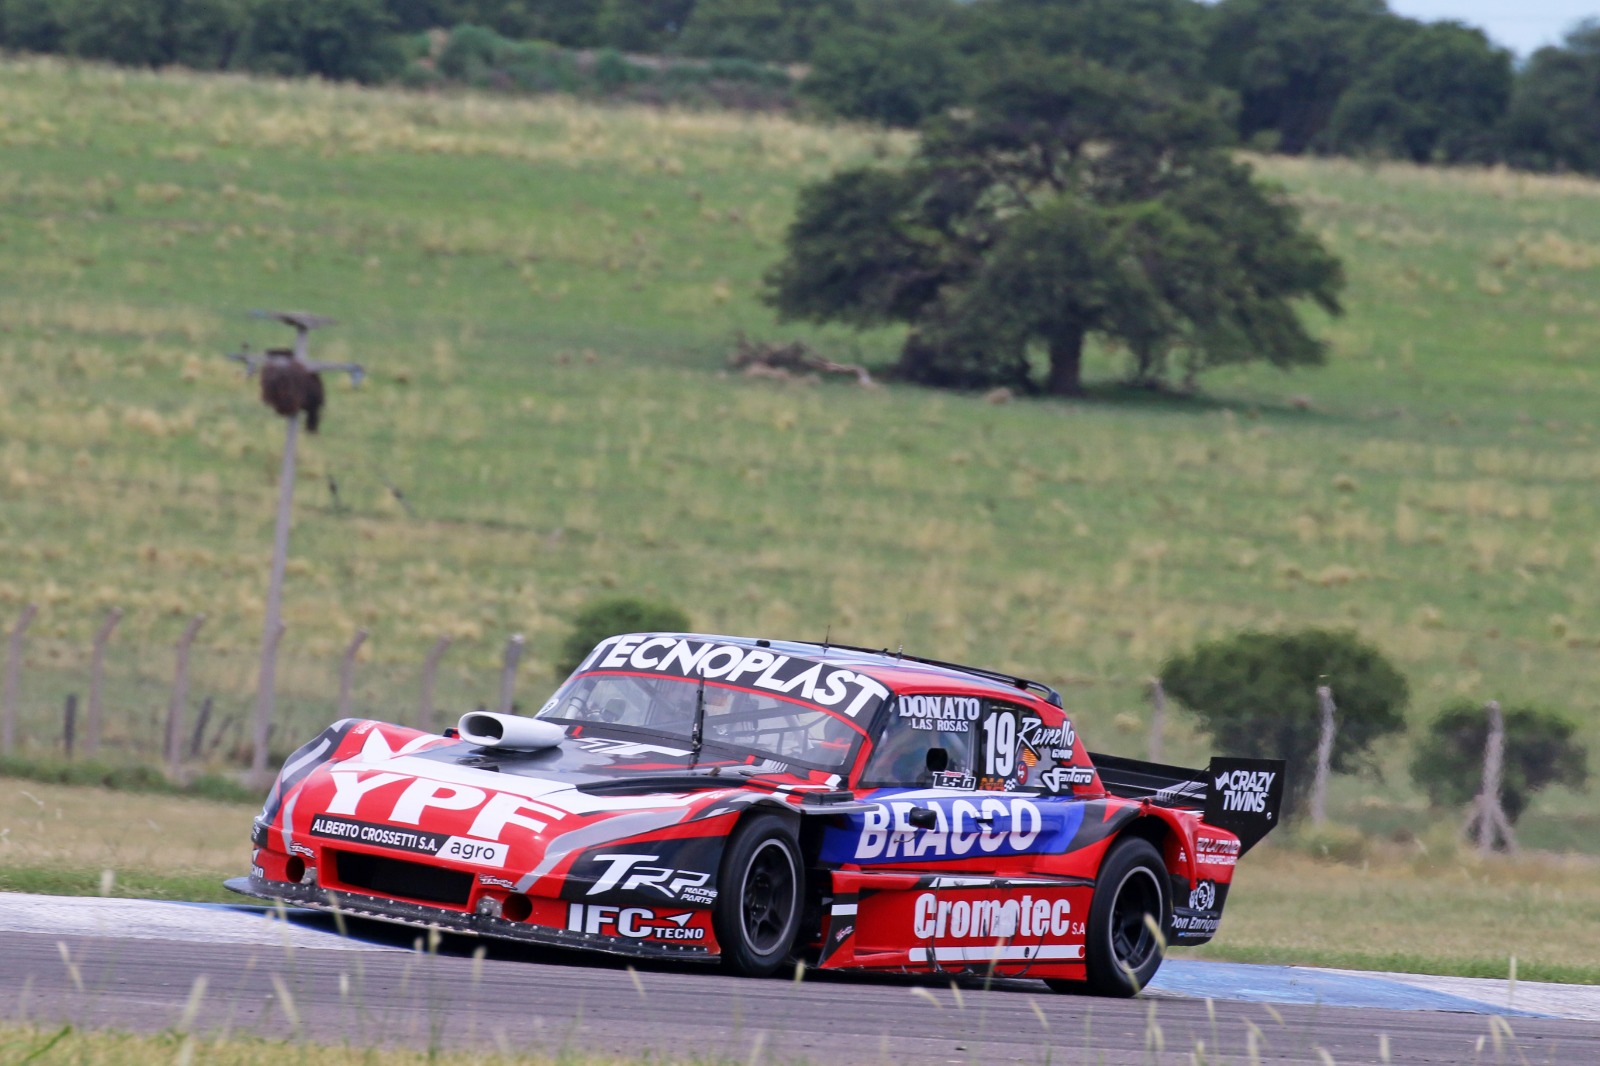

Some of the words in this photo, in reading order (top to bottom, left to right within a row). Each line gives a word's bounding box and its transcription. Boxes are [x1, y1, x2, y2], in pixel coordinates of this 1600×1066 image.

[581, 636, 889, 717] TECNOPLAST
[899, 695, 980, 720] DONATO
[912, 718, 933, 730] LAS
[937, 720, 969, 732] ROSAS
[984, 712, 1016, 776] 19
[1229, 770, 1276, 792] CRAZY
[325, 772, 567, 840] YPF
[1223, 790, 1266, 813] TWINS
[312, 818, 359, 838] ALBERTO
[360, 826, 418, 848] CROSSETTI
[418, 836, 438, 852] S.A.
[854, 799, 1042, 859] BRACCO
[450, 842, 495, 860] agro
[585, 854, 711, 898] TRP
[683, 887, 718, 898] RACING
[681, 894, 713, 904] PARTS
[914, 893, 1071, 939] Cromotec
[568, 903, 655, 938] IFC
[654, 927, 705, 939] TECNO
